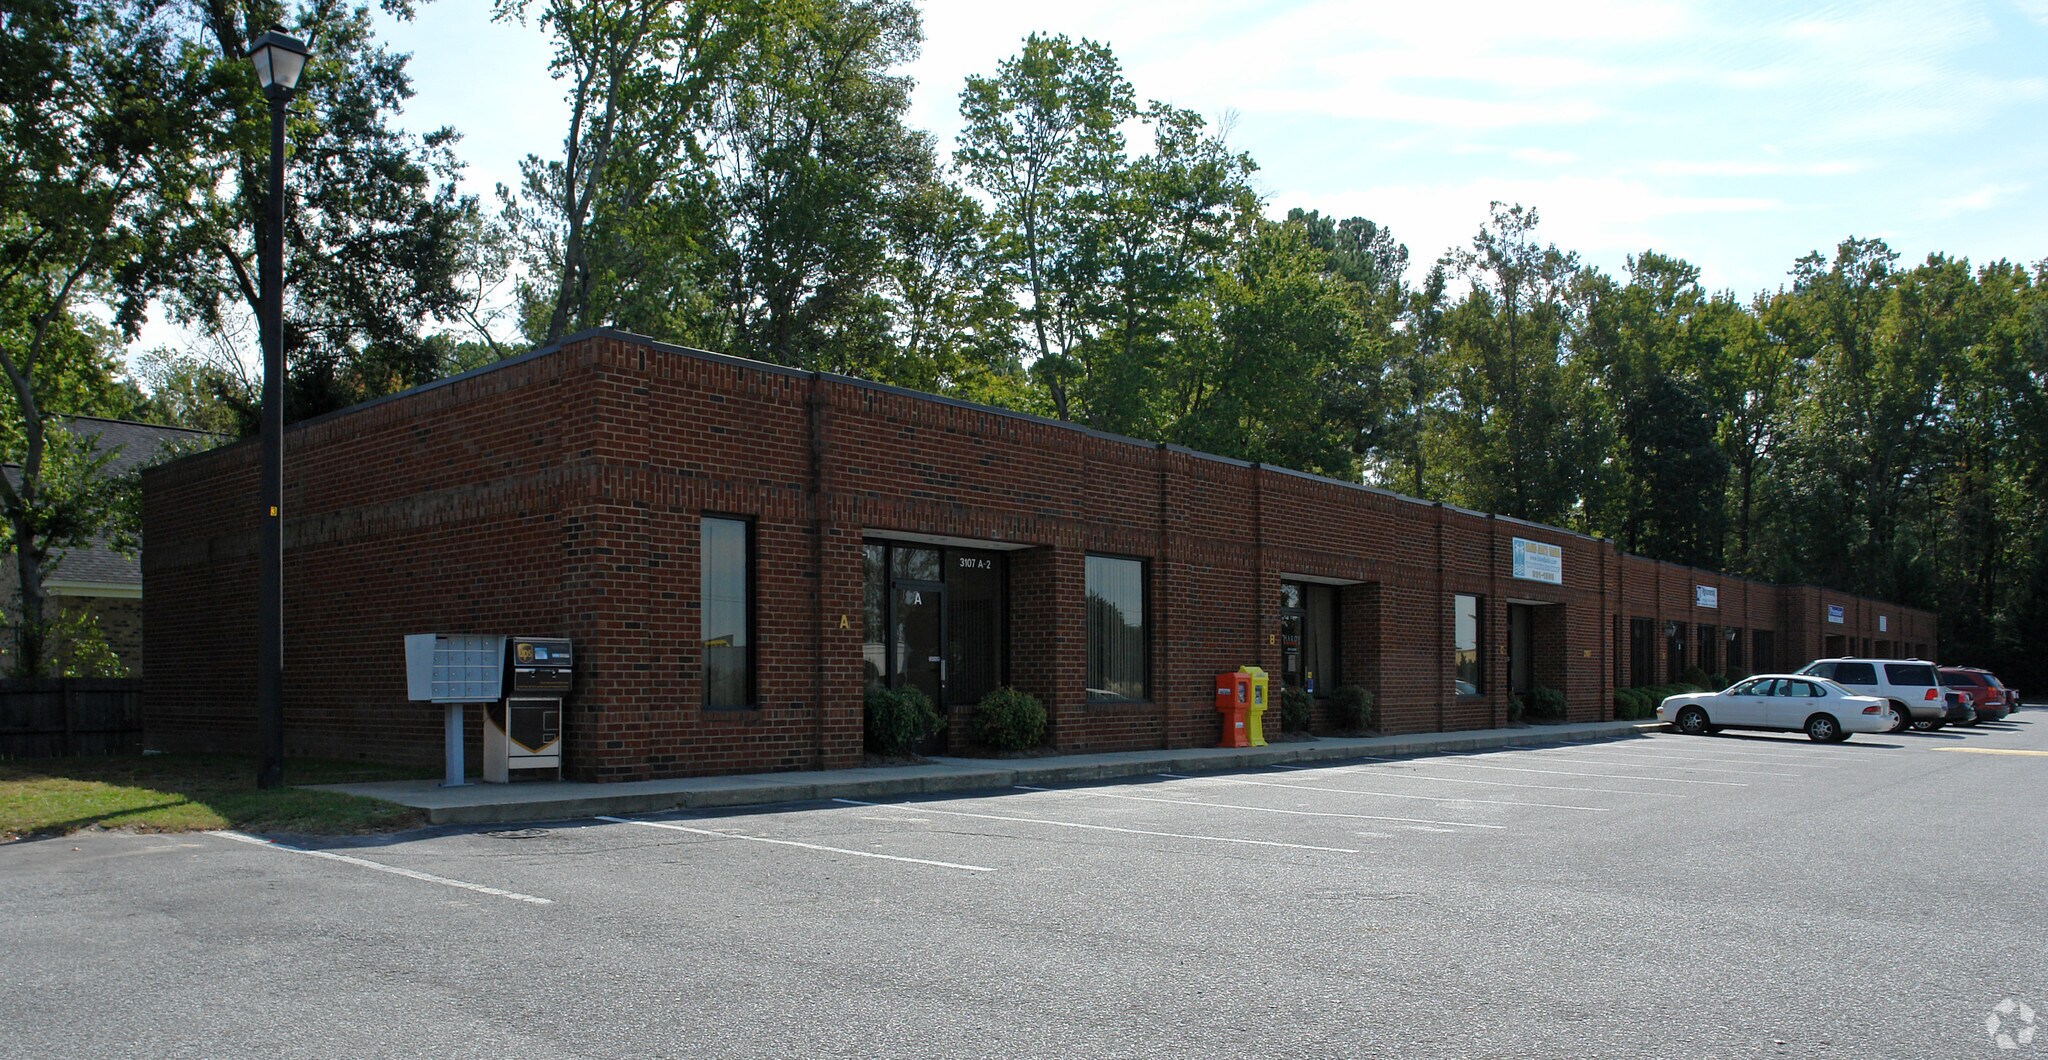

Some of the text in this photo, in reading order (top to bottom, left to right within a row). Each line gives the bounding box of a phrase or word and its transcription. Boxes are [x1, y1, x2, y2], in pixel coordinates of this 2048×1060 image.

[959, 557, 991, 570] 3107 A-2
[913, 591, 922, 605] A
[840, 614, 849, 630] A
[1269, 634, 1275, 645] B
[519, 649, 533, 661] ups
